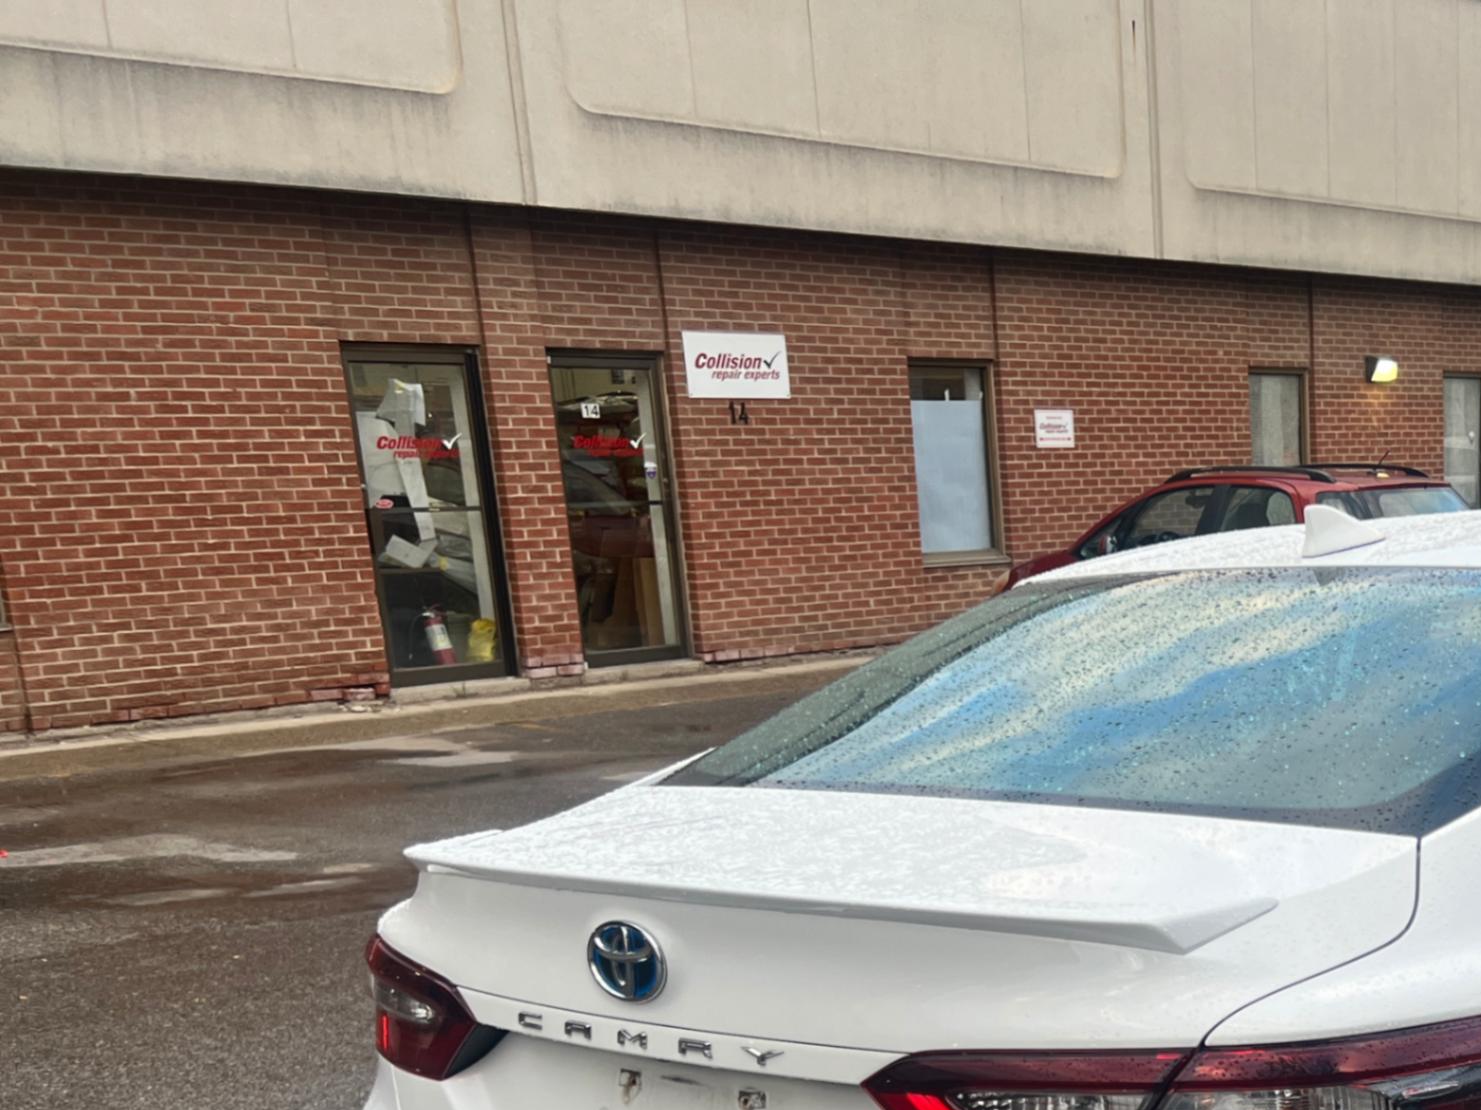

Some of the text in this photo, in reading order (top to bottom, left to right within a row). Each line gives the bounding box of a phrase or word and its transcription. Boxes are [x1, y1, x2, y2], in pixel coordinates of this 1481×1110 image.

[695, 352, 762, 370] Collision
[712, 369, 780, 381] repair experts
[584, 405, 599, 416] 14
[729, 401, 749, 424] 14
[518, 1011, 785, 1066] CAMRY
